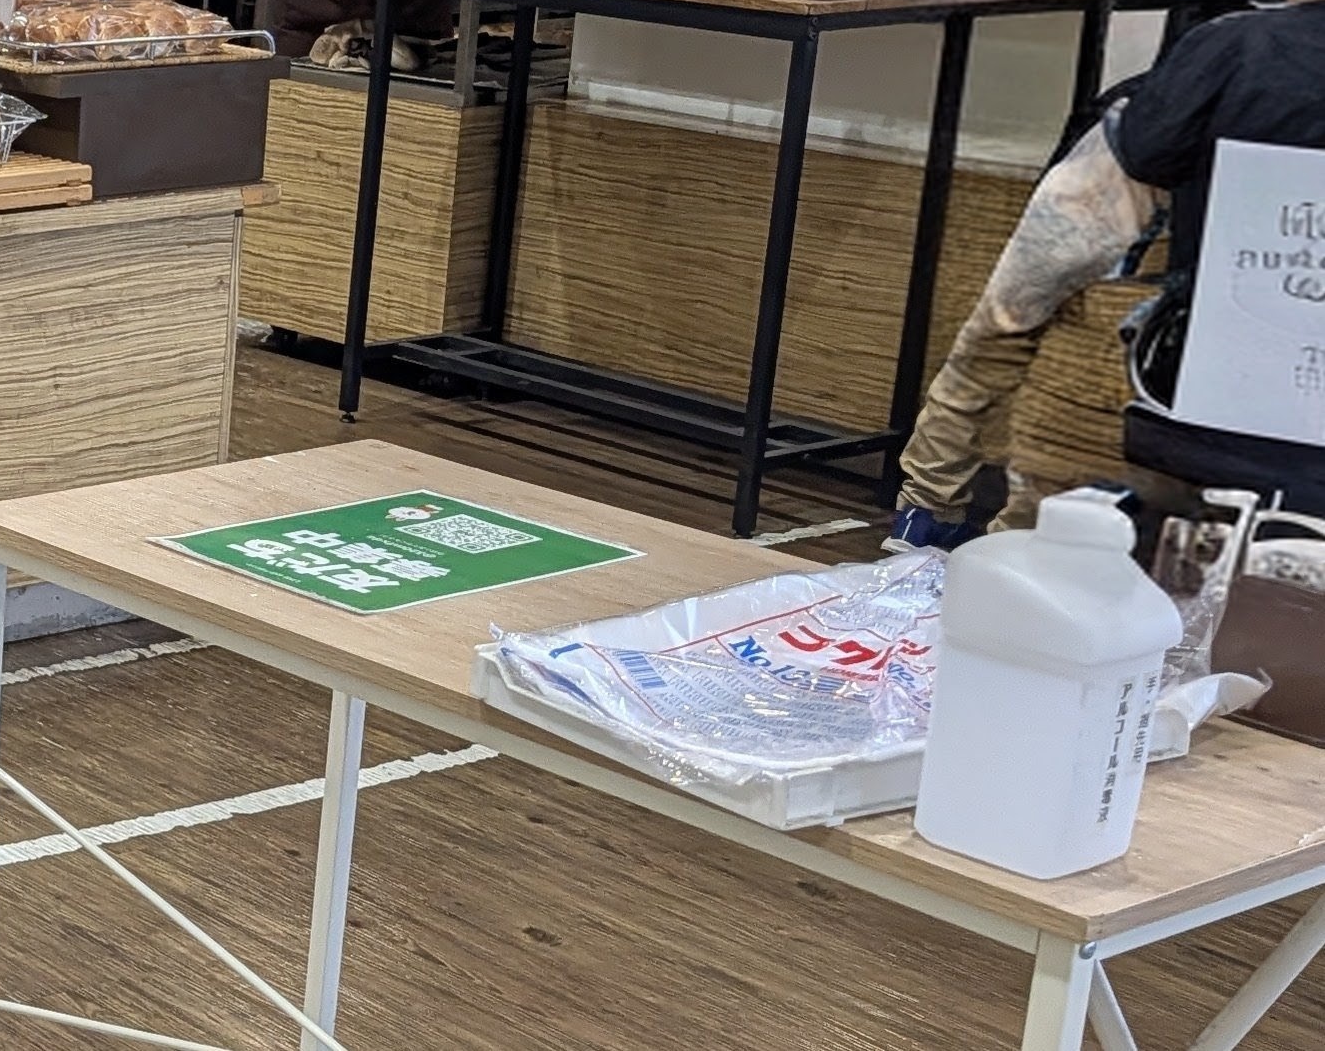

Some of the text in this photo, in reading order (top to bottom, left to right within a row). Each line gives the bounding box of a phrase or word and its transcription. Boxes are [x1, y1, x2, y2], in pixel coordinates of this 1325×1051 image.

[225, 538, 401, 594] 友だち
[281, 529, 452, 581] 募集中
[1096, 681, 1134, 824] アルコール消毒液
